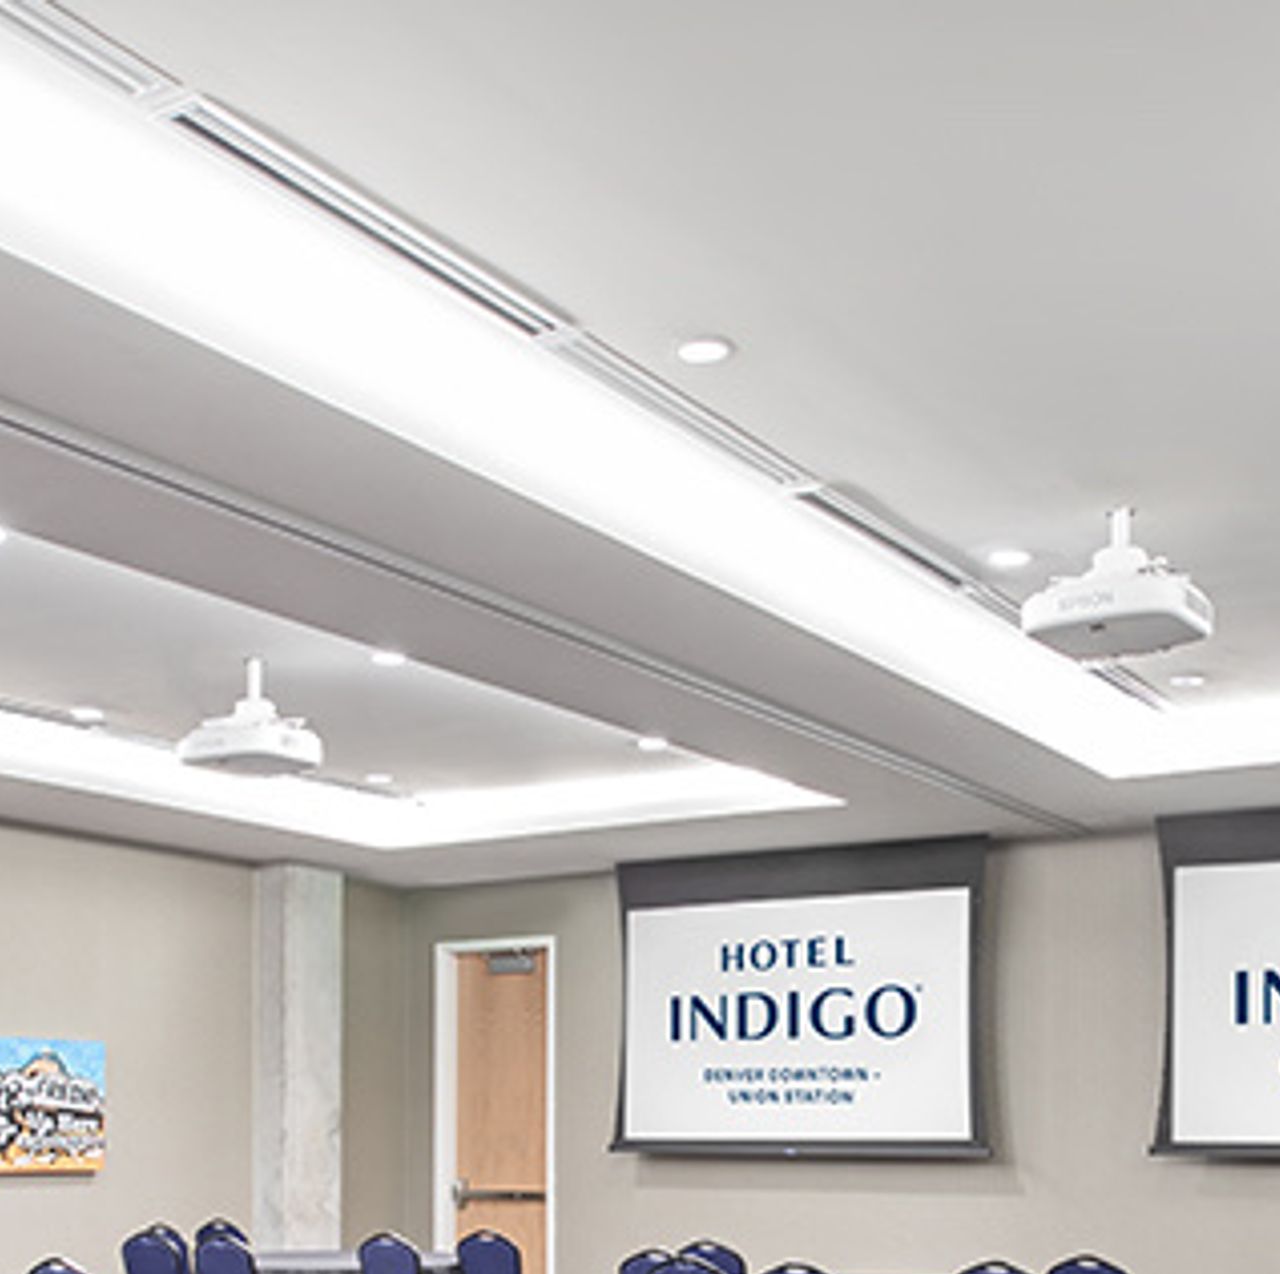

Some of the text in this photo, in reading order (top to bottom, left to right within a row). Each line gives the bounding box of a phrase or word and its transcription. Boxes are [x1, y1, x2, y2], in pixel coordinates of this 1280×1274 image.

[720, 935, 854, 973] HOTEL
[669, 984, 917, 1042] INDIGO
[703, 1067, 764, 1082] DENVER
[767, 1066, 869, 1082] DOWNTOWN
[727, 1088, 853, 1104] UNION STATION
